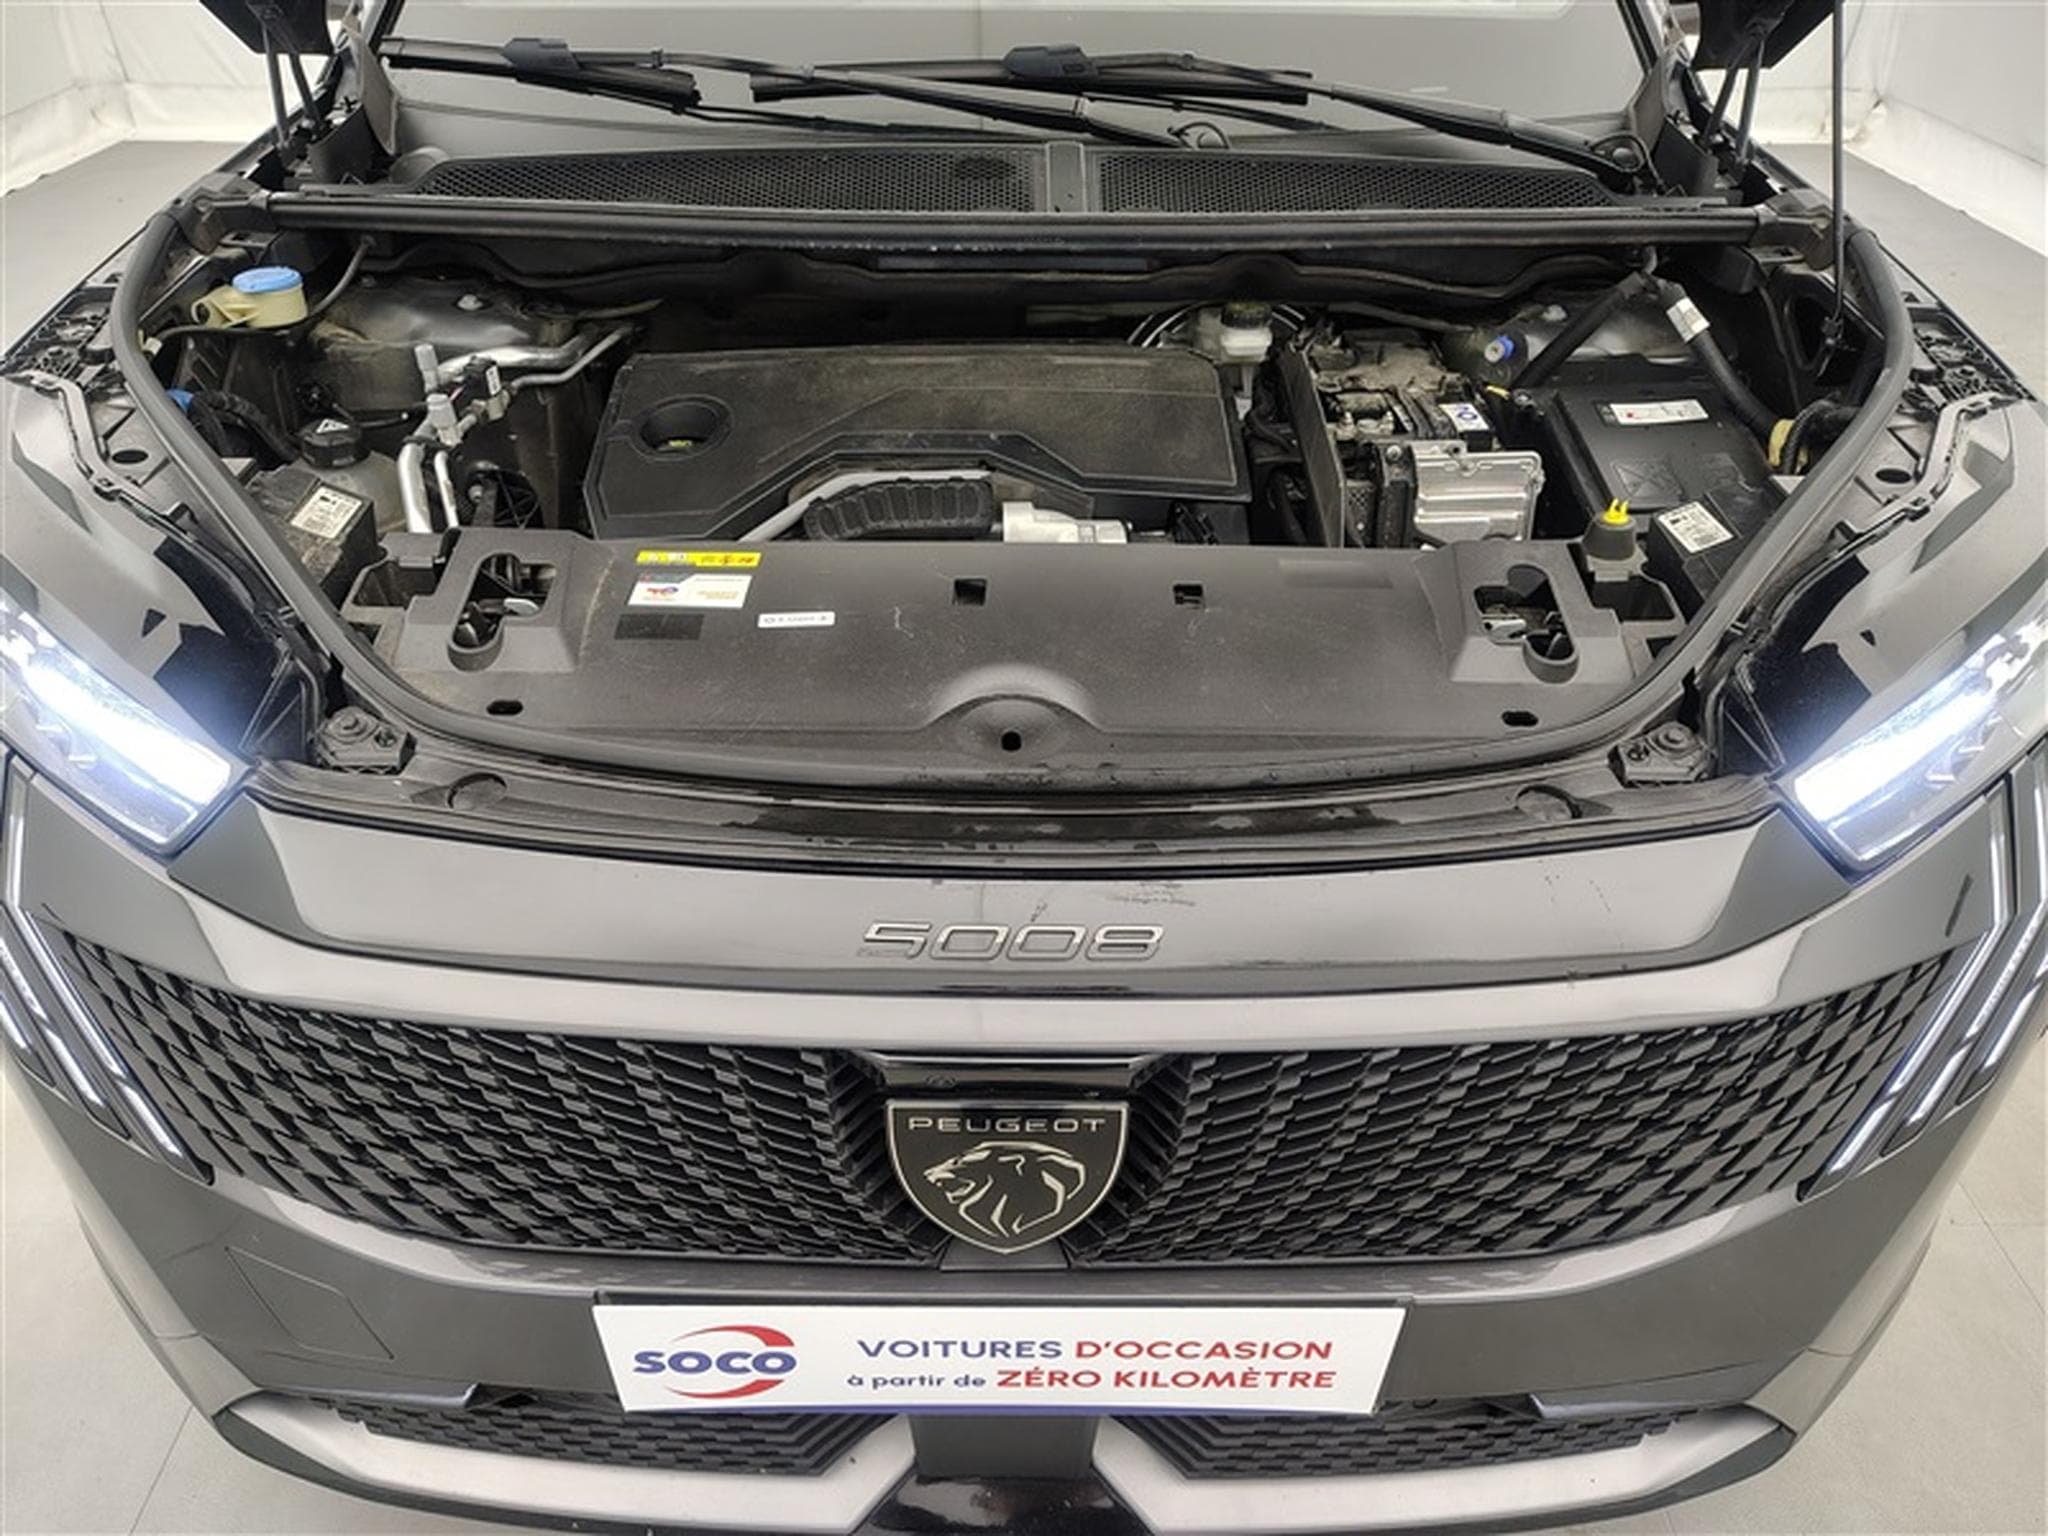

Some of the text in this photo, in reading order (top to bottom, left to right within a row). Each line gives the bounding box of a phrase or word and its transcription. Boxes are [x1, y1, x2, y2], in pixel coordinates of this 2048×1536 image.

[857, 920, 1164, 961] 5008
[908, 1116, 1106, 1132] PEUGEOT
[857, 1340, 1334, 1360] VOITURES D'OCCASION
[633, 1351, 797, 1375] SOCO
[847, 1366, 1337, 1390] à partir de ZÉRO KILOMÈTRE
